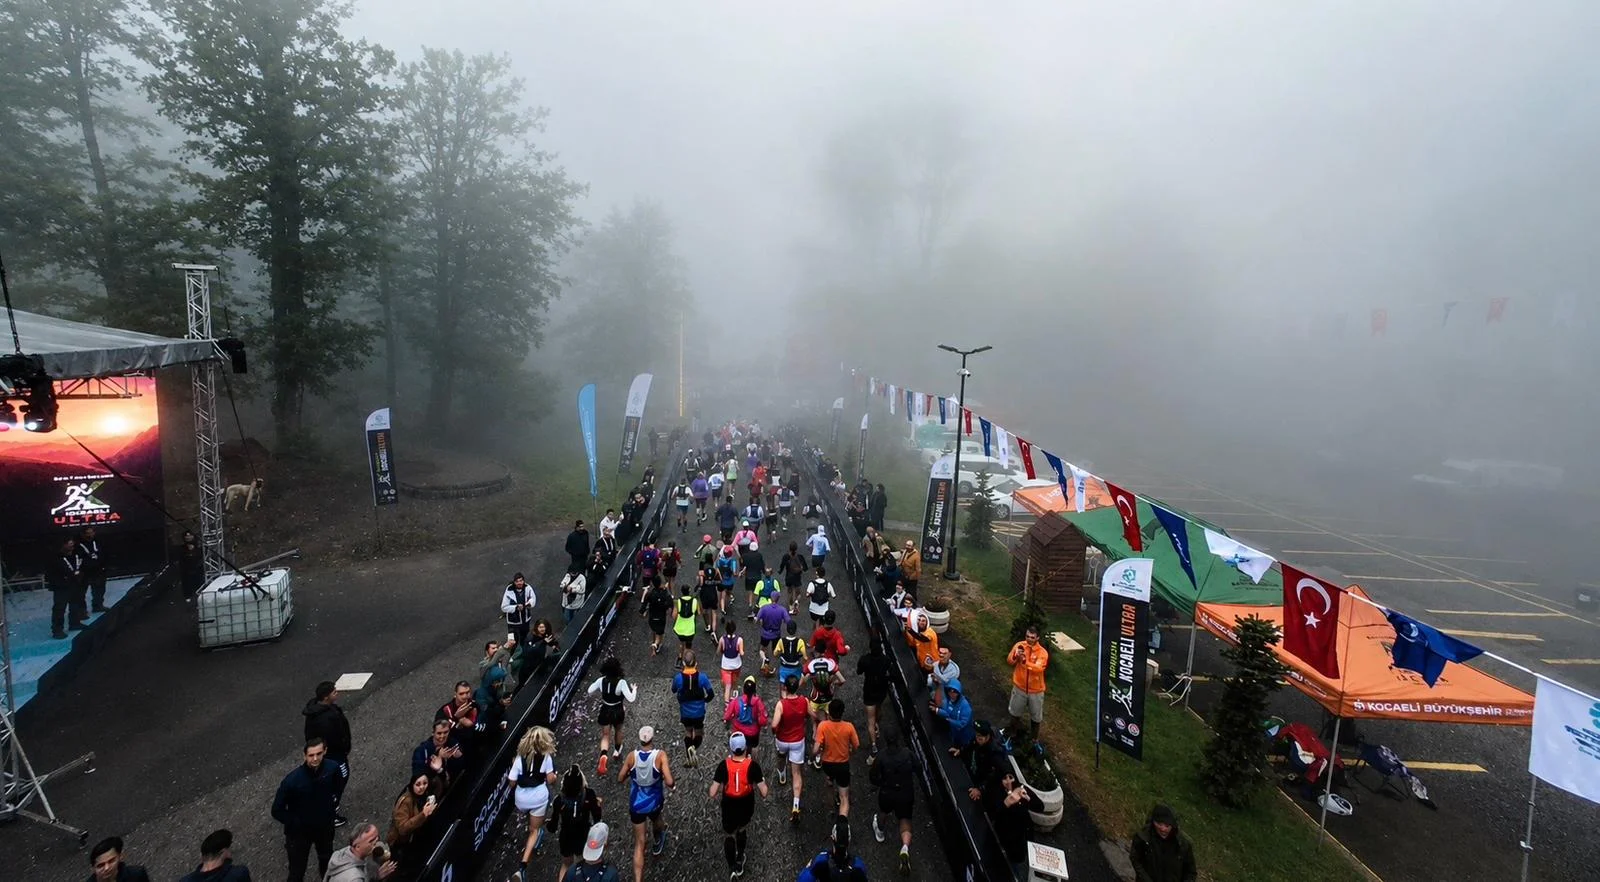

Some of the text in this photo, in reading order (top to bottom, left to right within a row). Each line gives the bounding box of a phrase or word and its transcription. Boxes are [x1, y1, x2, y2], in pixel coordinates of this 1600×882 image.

[54, 512, 120, 524] ULTRA
[1118, 637, 1135, 683] KOCAELI
[1368, 702, 1421, 712] KOCAELİ
[1423, 703, 1502, 716] BÜYÜKŞEHİR
